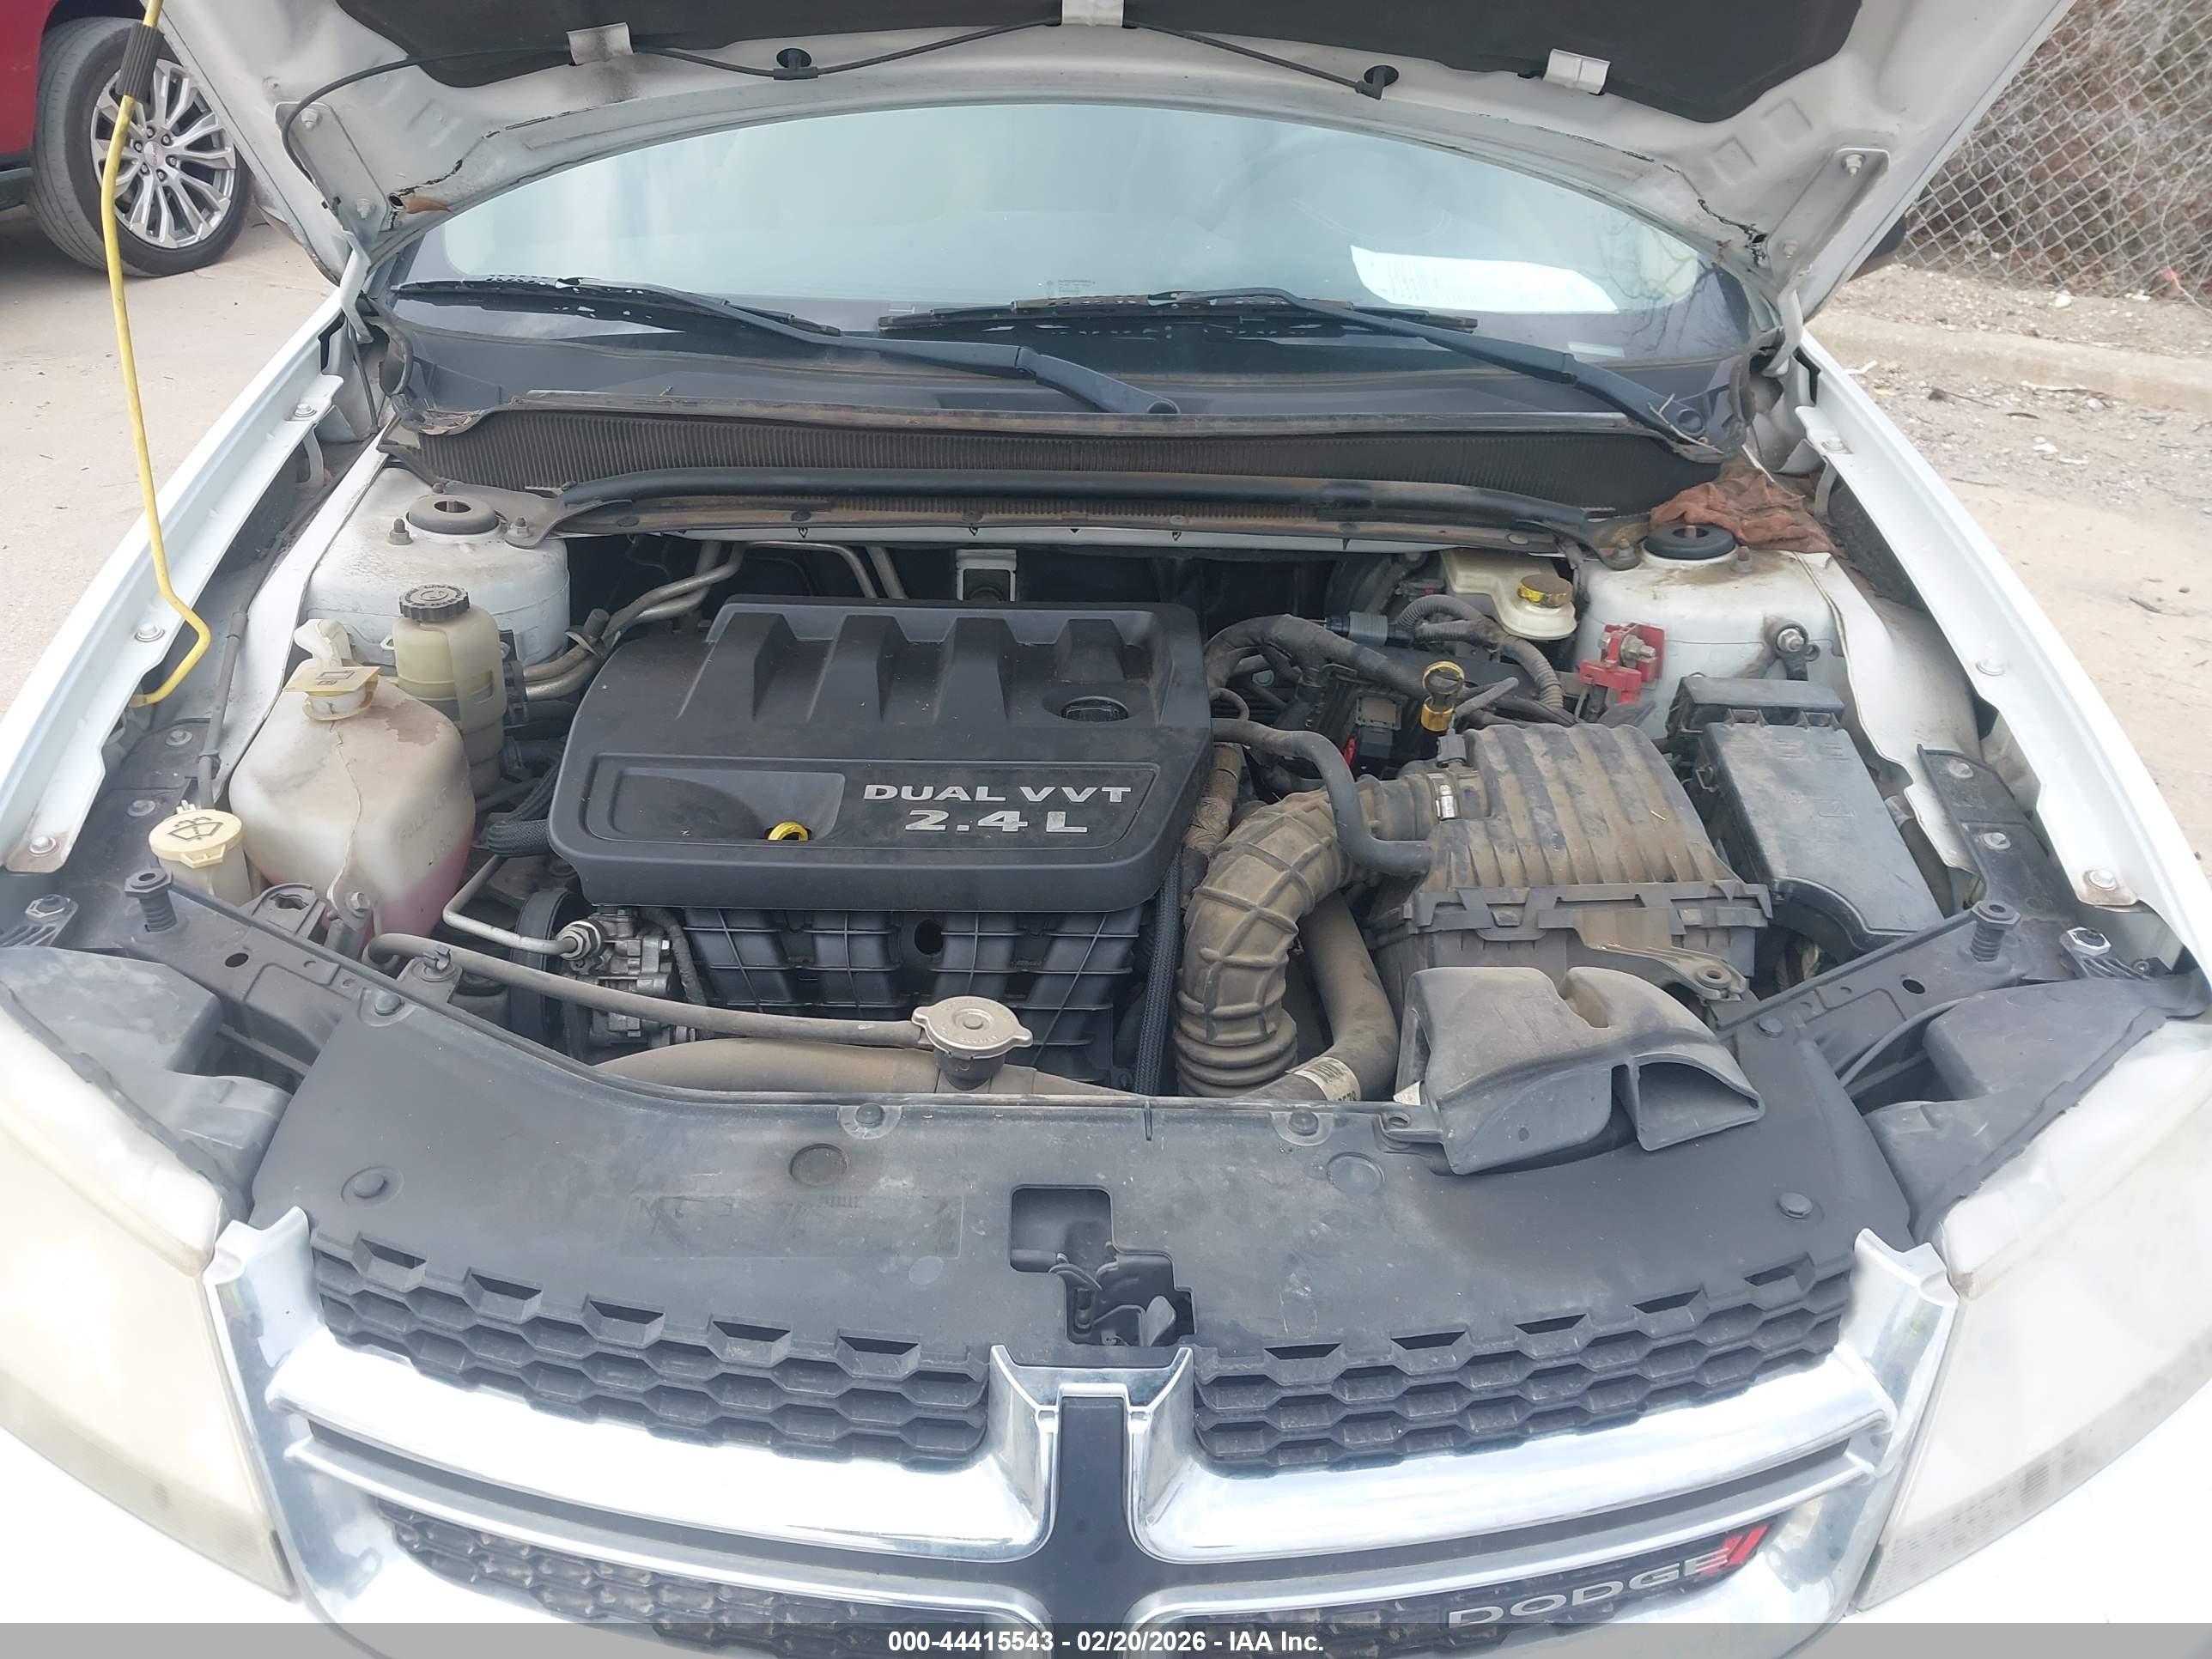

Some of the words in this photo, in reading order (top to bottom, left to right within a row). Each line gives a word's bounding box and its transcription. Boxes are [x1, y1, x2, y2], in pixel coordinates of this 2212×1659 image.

[863, 783, 1007, 802] DUAL
[1018, 786, 1132, 804] VVT
[1448, 1546, 1730, 1629] DODGE
